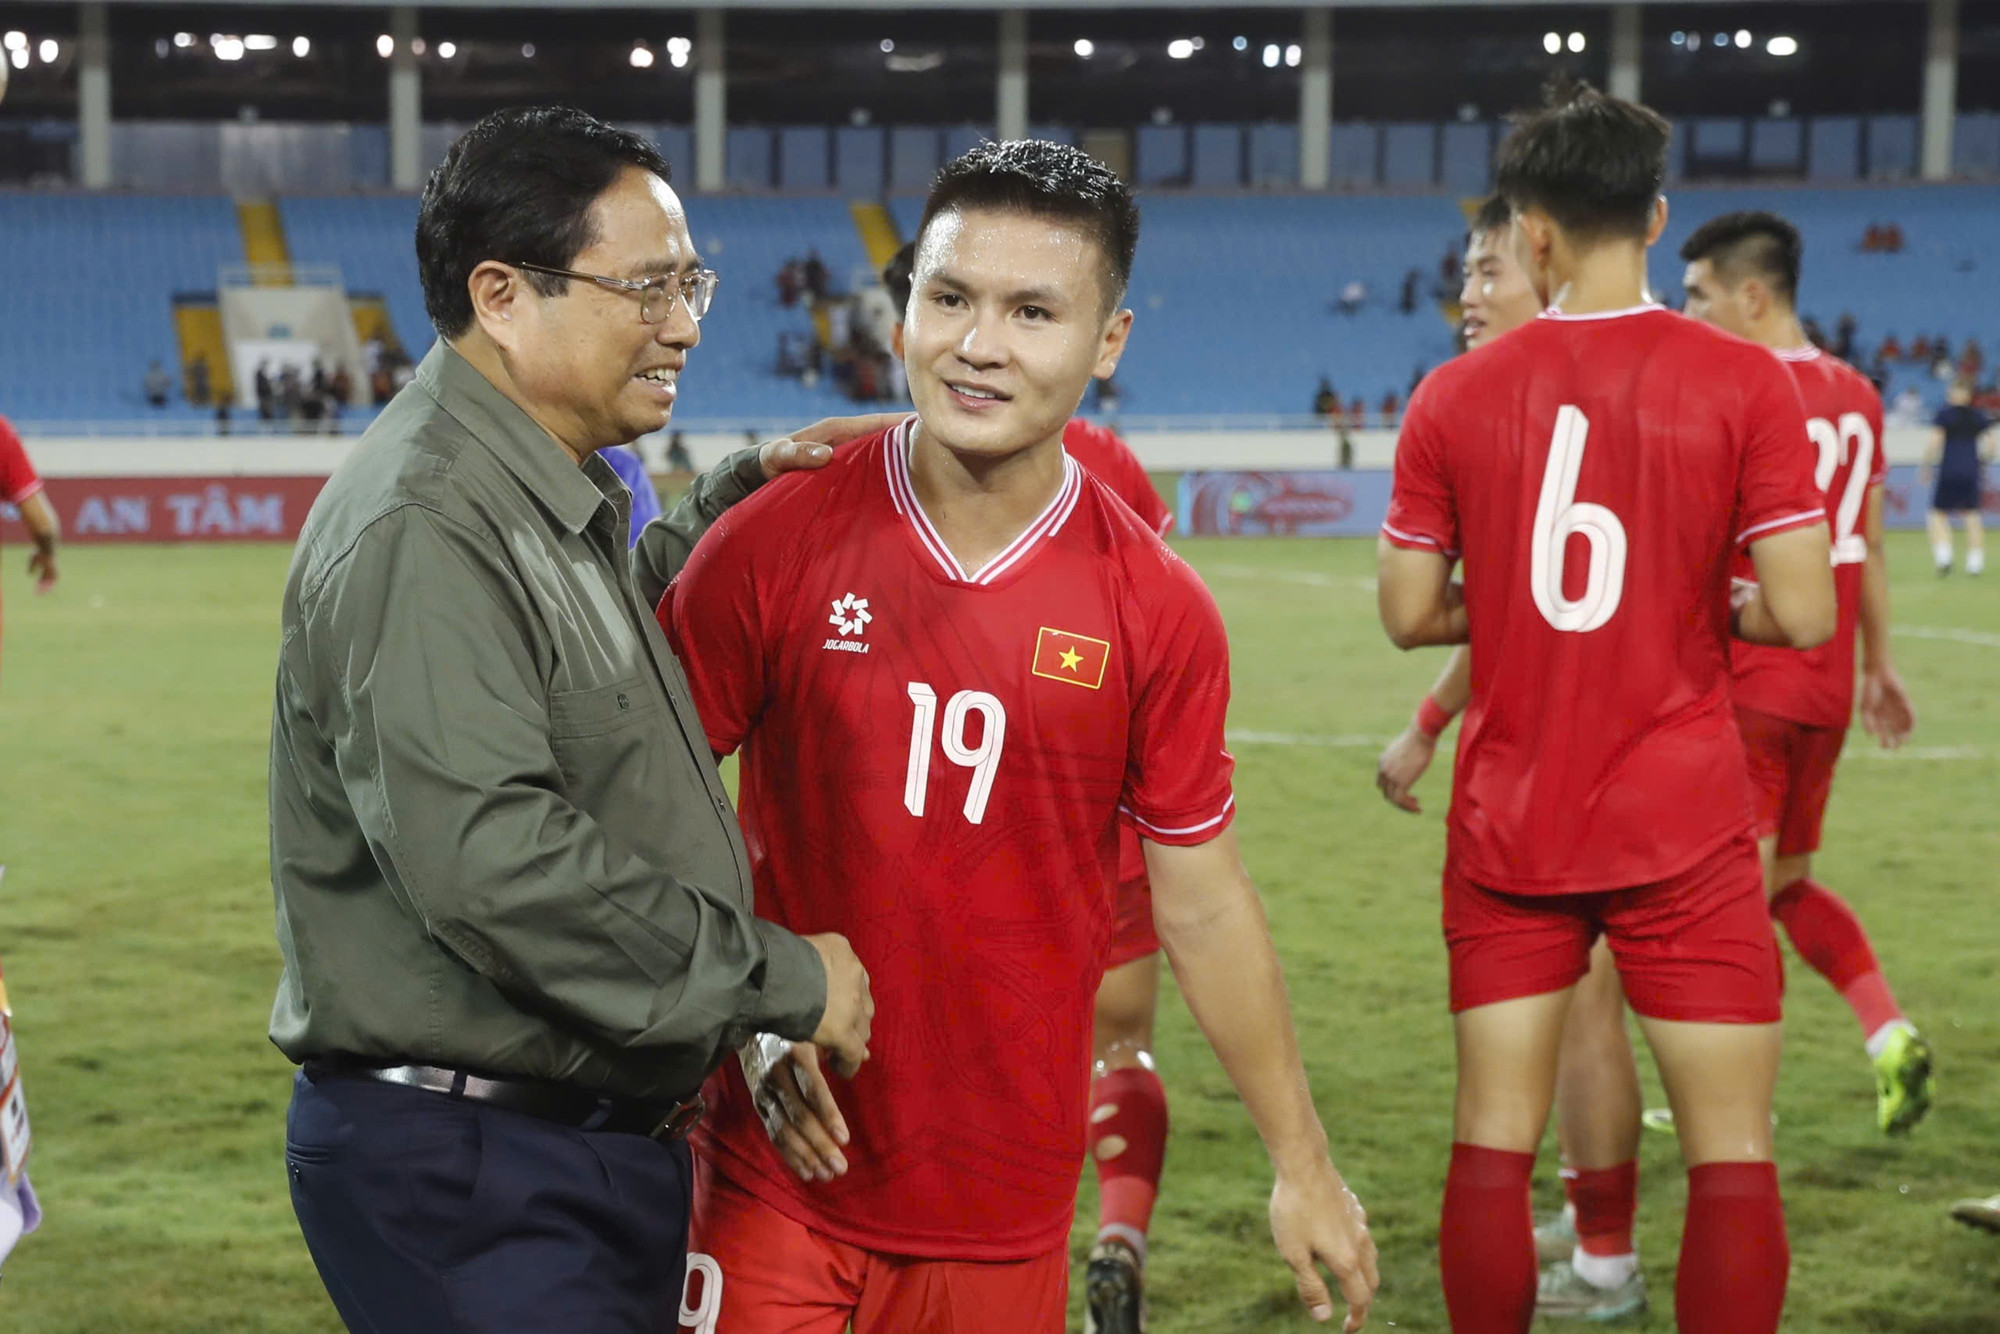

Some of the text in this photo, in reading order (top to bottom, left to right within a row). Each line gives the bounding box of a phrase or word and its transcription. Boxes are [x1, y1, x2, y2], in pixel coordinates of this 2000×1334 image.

[75, 484, 284, 534] AN TÂM
[1530, 404, 1627, 633] 6
[903, 681, 1007, 825] 19
